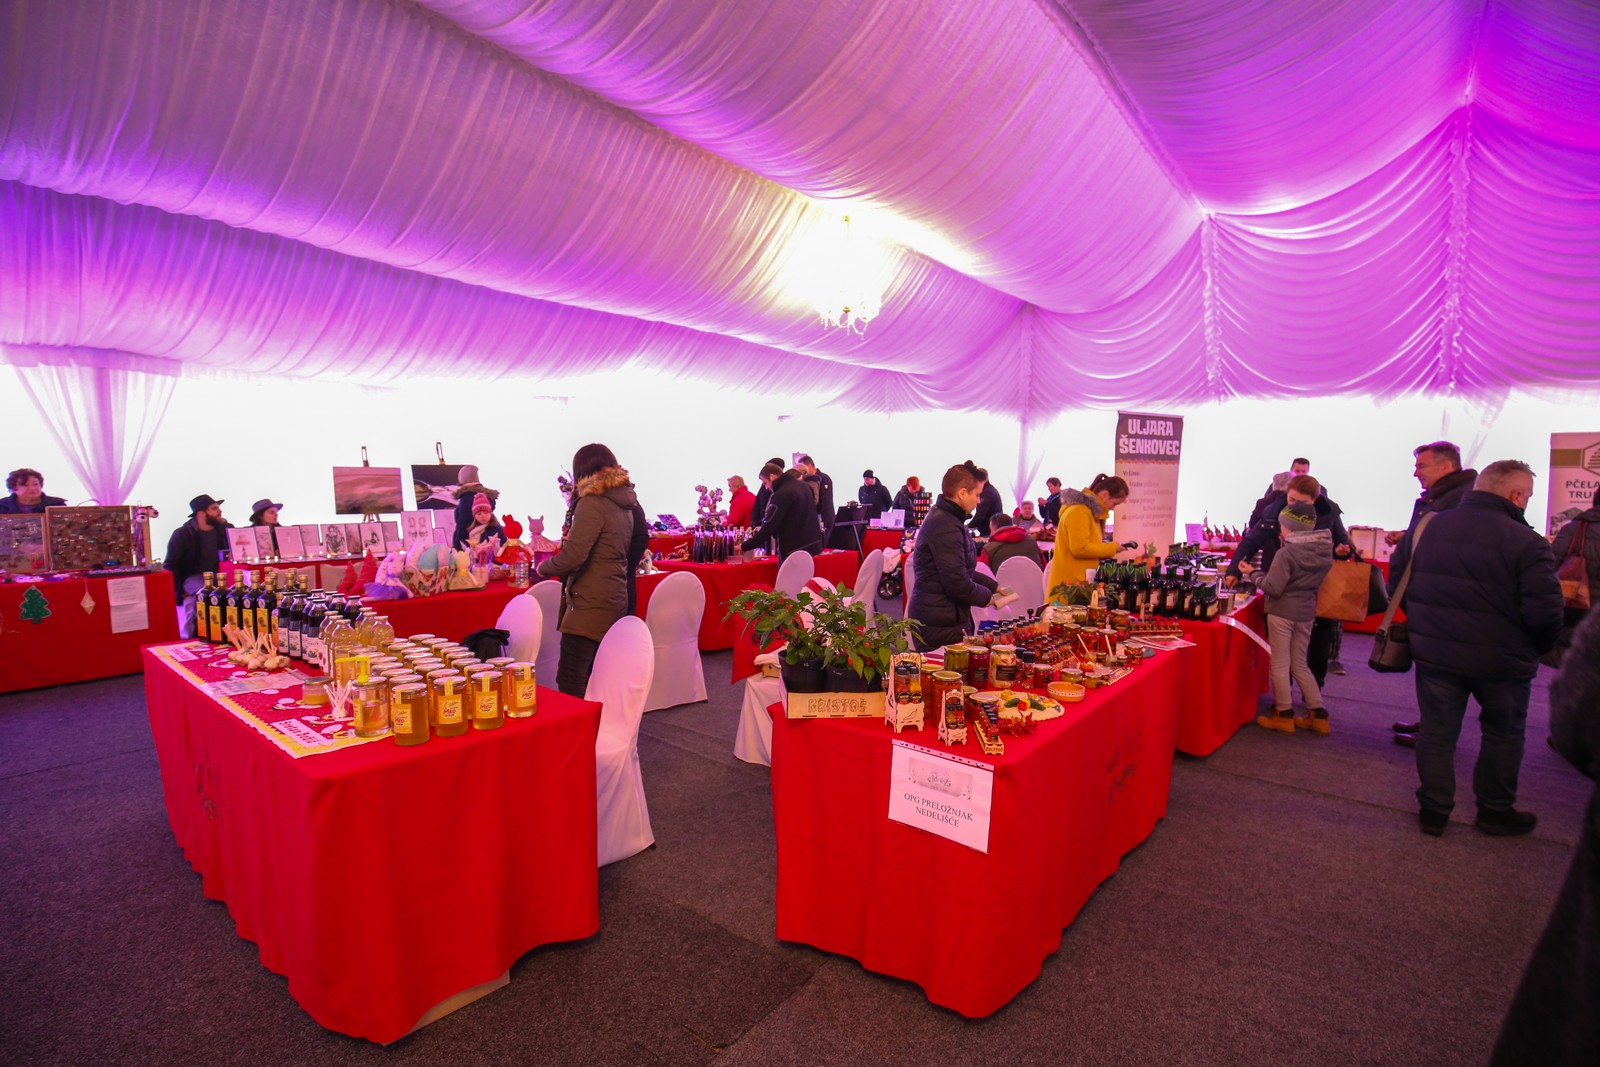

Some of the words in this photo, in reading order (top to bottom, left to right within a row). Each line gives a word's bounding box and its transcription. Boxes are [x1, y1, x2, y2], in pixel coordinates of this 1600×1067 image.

[1128, 418, 1173, 436] ULJARA
[1119, 434, 1180, 455] ŠENKOVEC
[904, 792, 920, 804] OPG
[921, 797, 974, 822] PRELOŽNJAK
